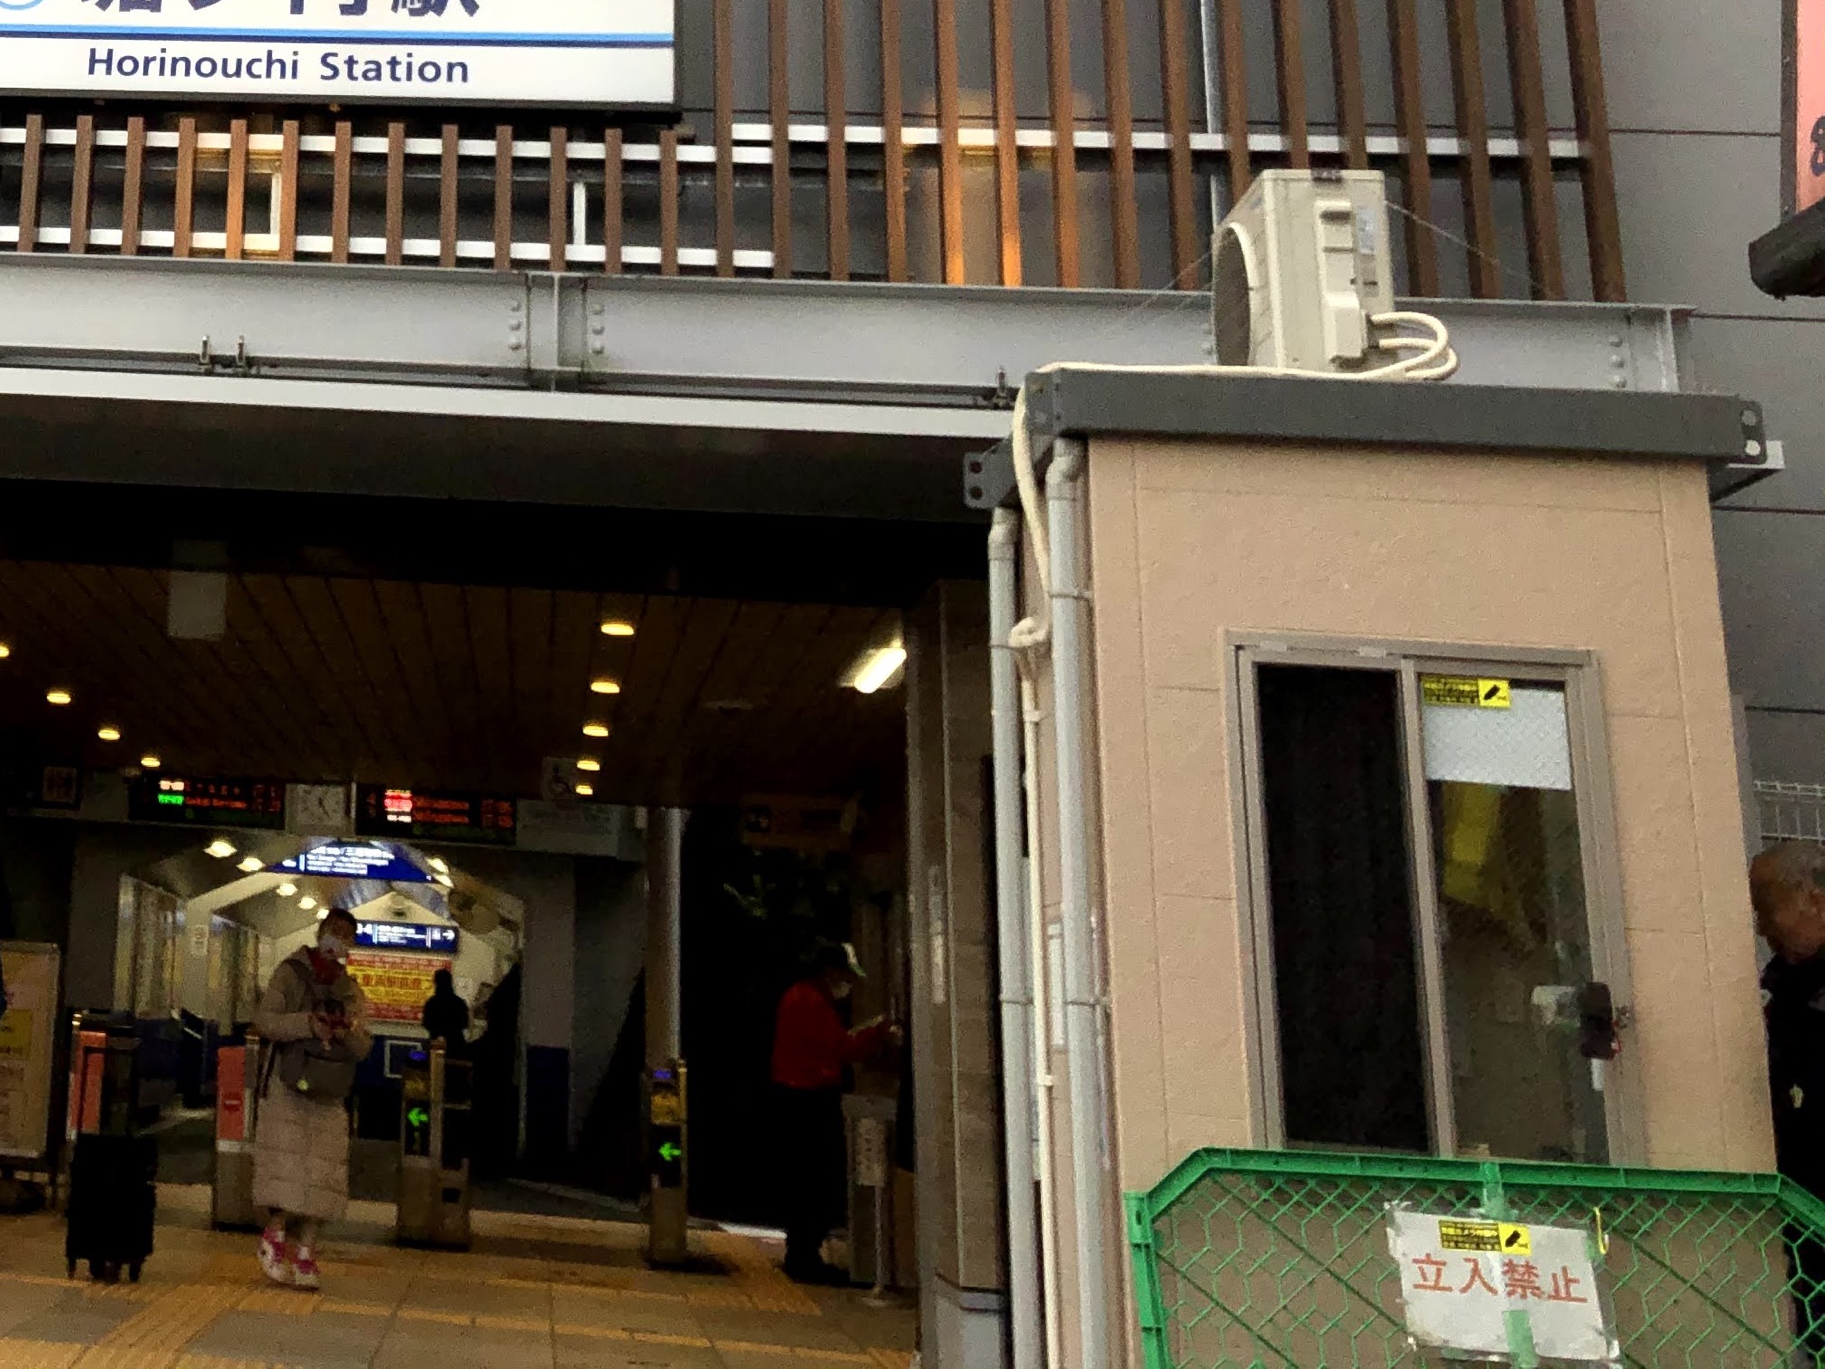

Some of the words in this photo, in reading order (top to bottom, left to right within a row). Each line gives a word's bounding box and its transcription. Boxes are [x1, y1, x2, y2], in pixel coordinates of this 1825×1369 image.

[87, 47, 299, 80] Horinouchi
[320, 51, 470, 83] Station
[1412, 1252, 1589, 1304] 立入禁止
